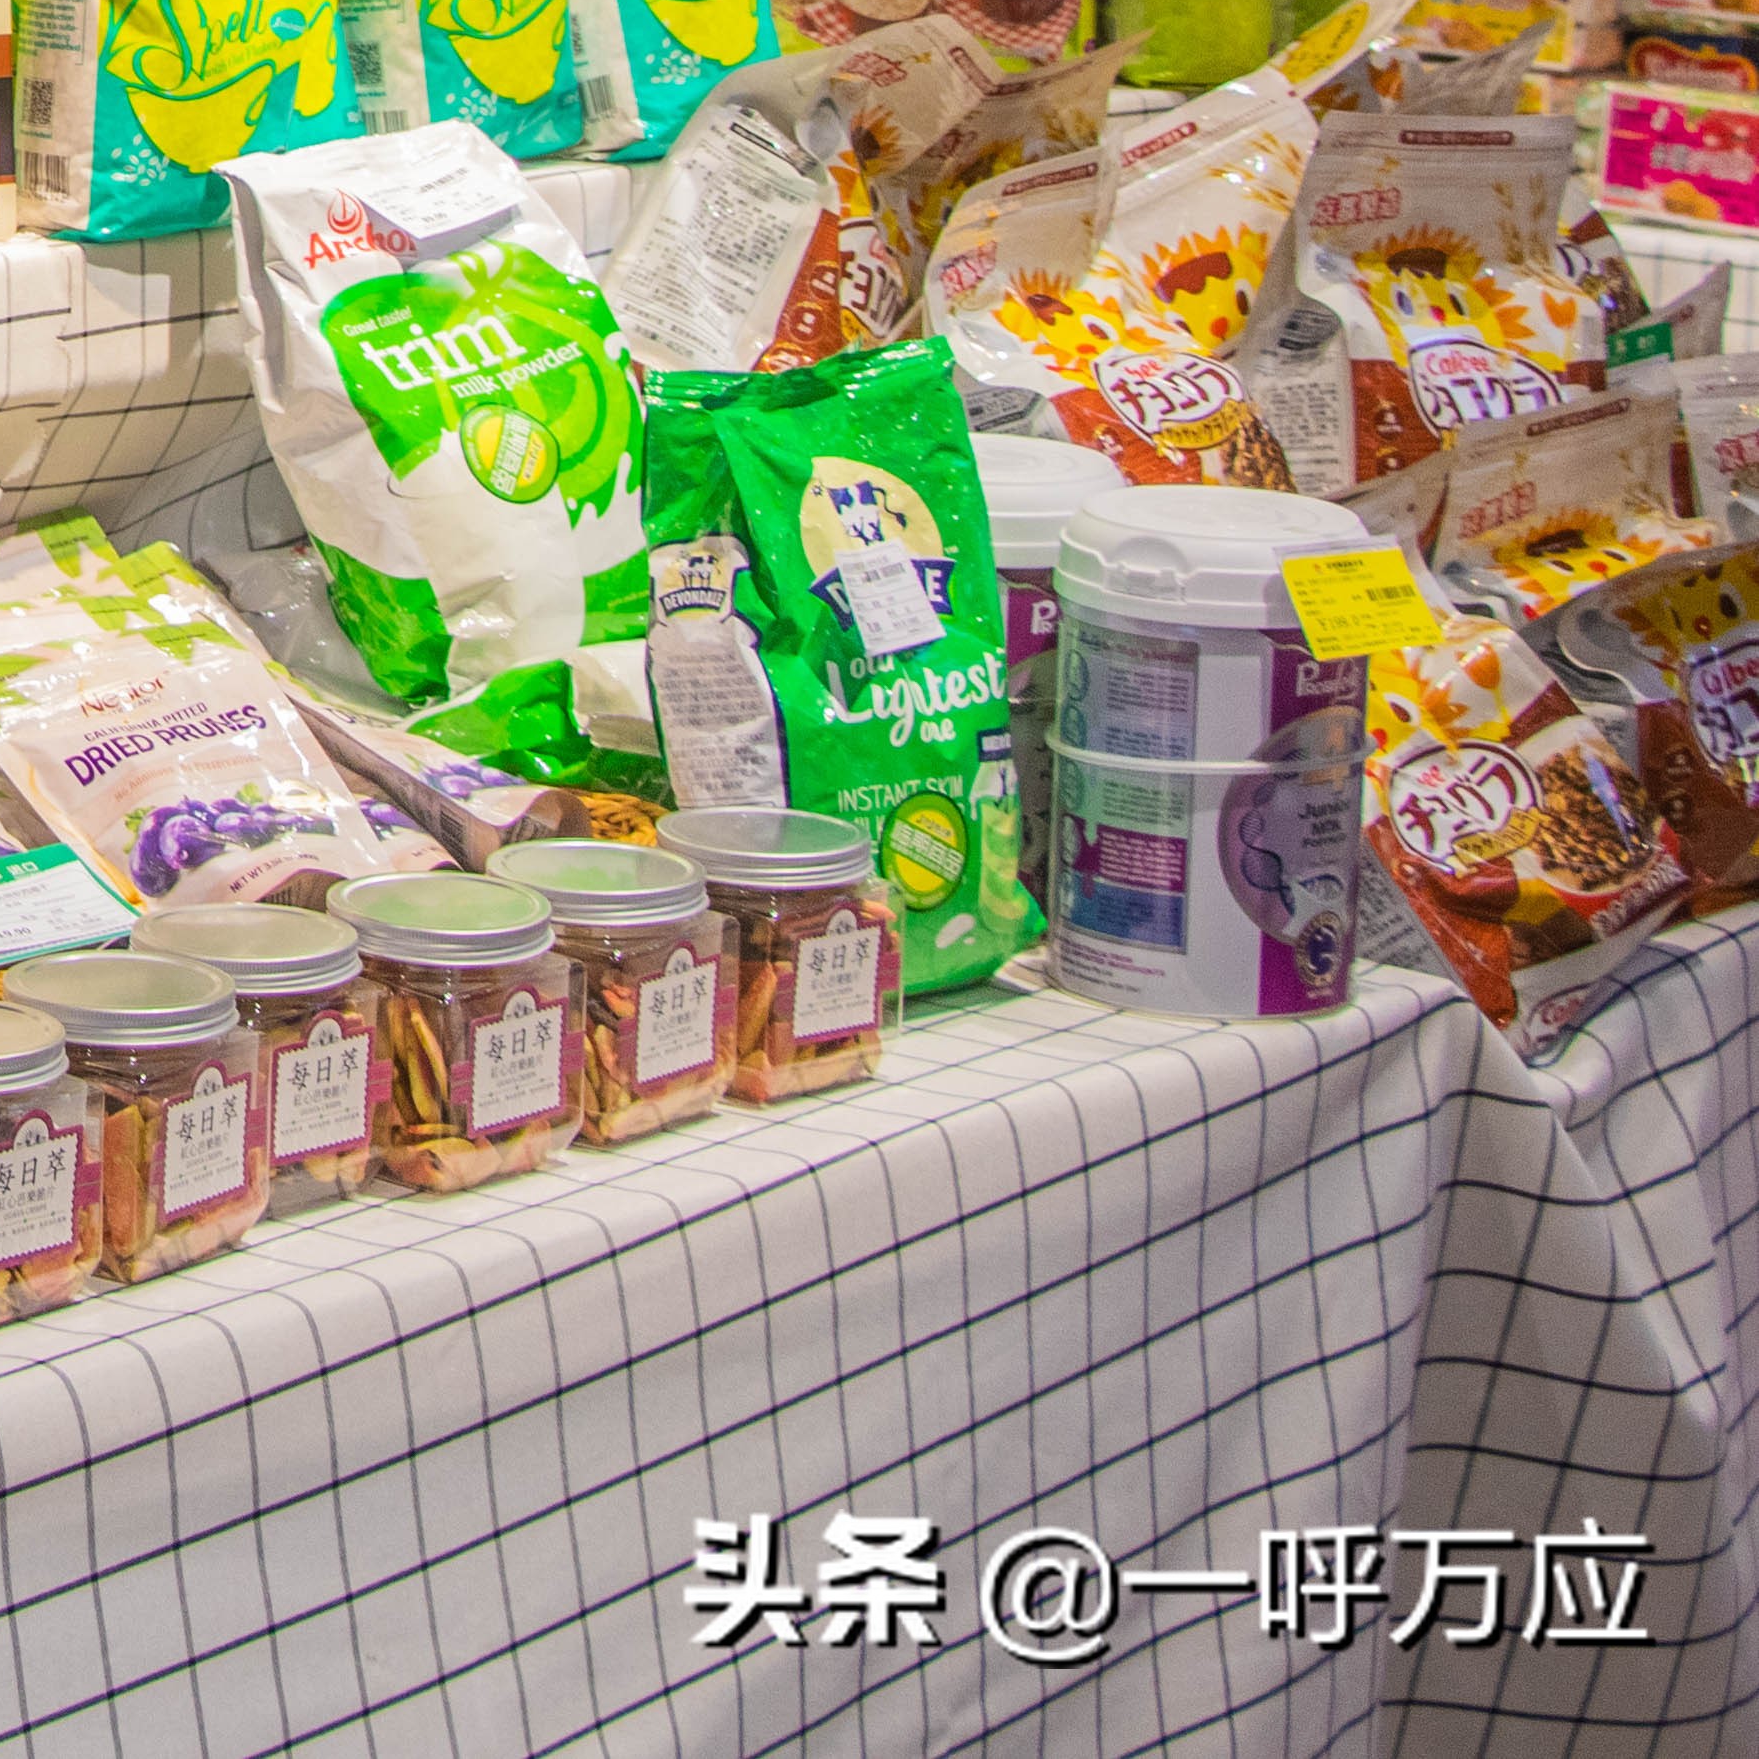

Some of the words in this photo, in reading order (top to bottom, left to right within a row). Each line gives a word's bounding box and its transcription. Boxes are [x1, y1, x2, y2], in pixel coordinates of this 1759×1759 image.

[342, 317, 378, 337] Great
[359, 314, 527, 391] trim
[450, 375, 501, 398] milk
[494, 341, 584, 390] powder
[162, 702, 208, 725] PITTED
[824, 648, 1008, 748] Lightest
[64, 733, 155, 787] DRIED
[152, 705, 267, 747] PRUNES
[919, 718, 956, 743] one
[837, 779, 922, 813] INSTANT
[230, 876, 249, 893] NET
[249, 866, 264, 881] WT
[805, 936, 869, 980] 每日萃
[649, 971, 708, 1017] 每日萃
[483, 1016, 556, 1064] 每日萃
[286, 1046, 360, 1090] 每日萃
[174, 1095, 239, 1145] 每日萃
